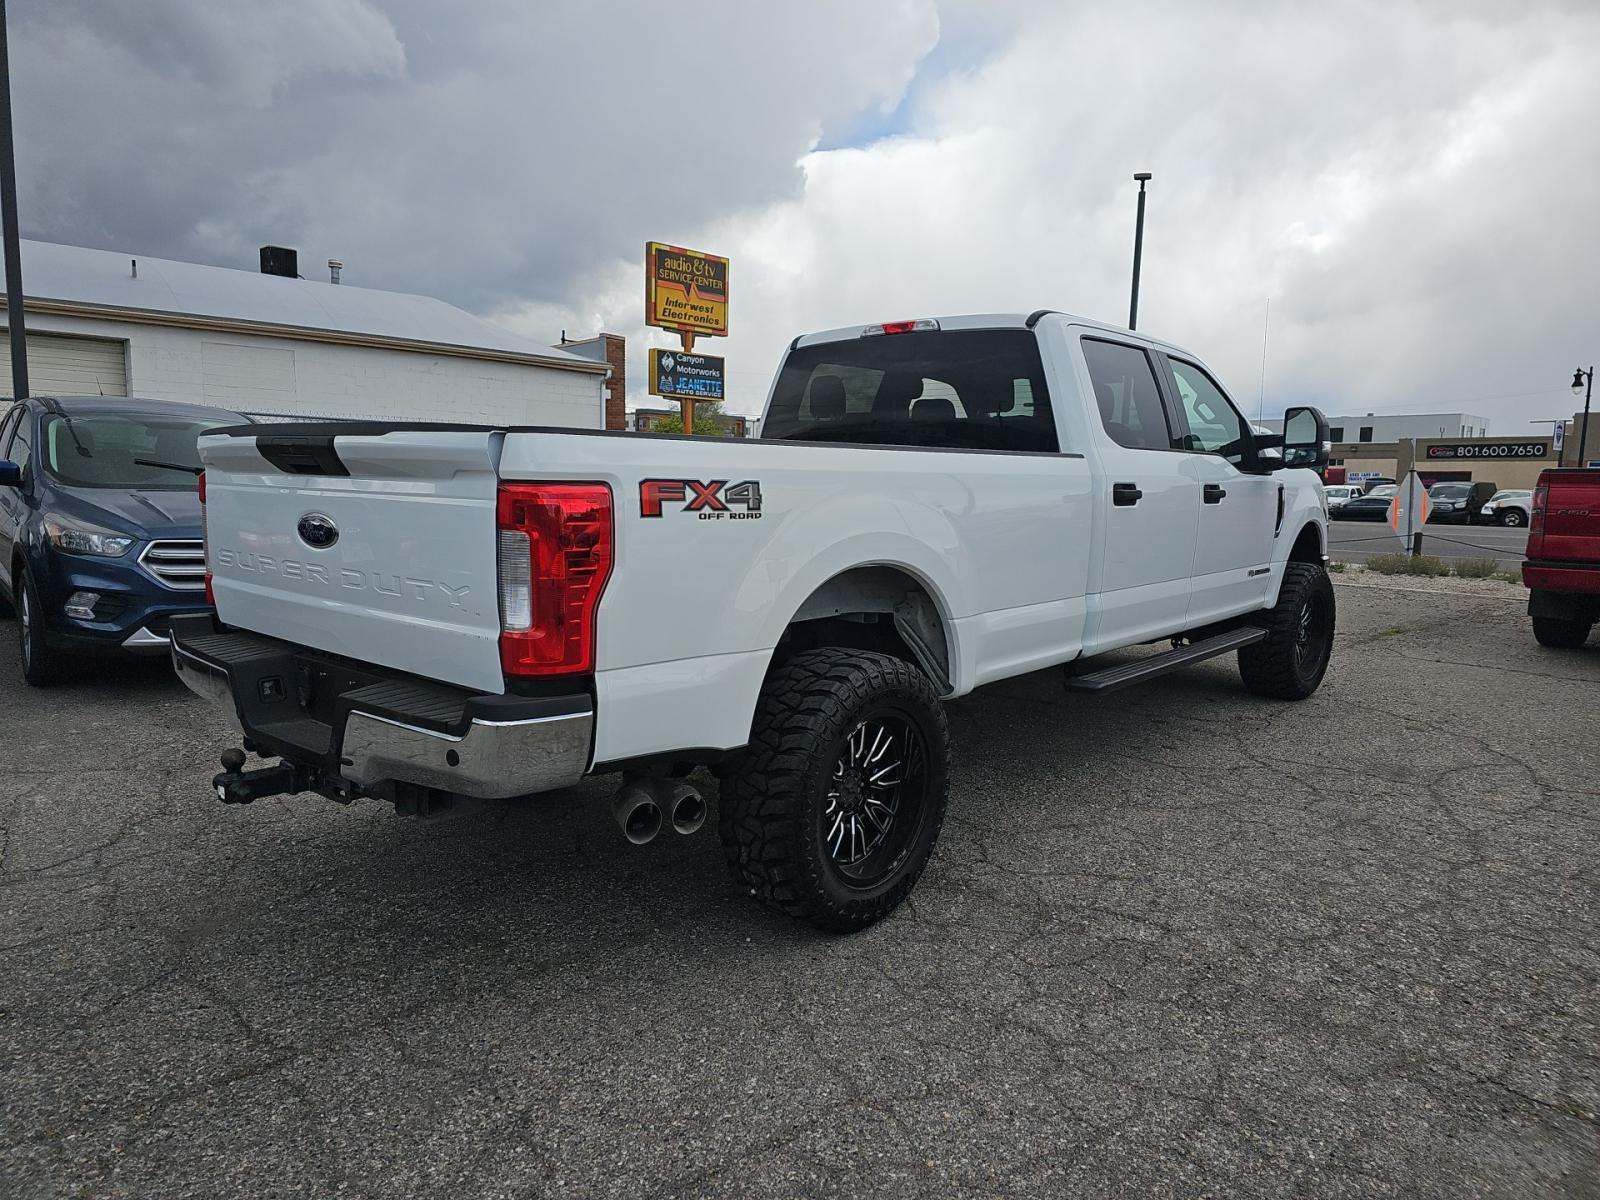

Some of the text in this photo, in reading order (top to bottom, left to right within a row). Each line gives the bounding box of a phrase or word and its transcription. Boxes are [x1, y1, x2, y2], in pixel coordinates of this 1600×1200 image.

[664, 257, 716, 277] audio & tv
[659, 268, 723, 289] SERVICE CENTER
[665, 297, 714, 314] Interwest
[662, 308, 720, 325] Electronics
[676, 354, 705, 365] Canyon
[676, 365, 720, 378] Motorworks
[676, 377, 722, 393] JEANETTE
[695, 390, 722, 398] SERVICE
[1457, 445, 1544, 457] 801.600.7650
[639, 479, 762, 518] FX4
[698, 512, 762, 520] OFF ROAD
[217, 549, 472, 607] SUPER DUTY
